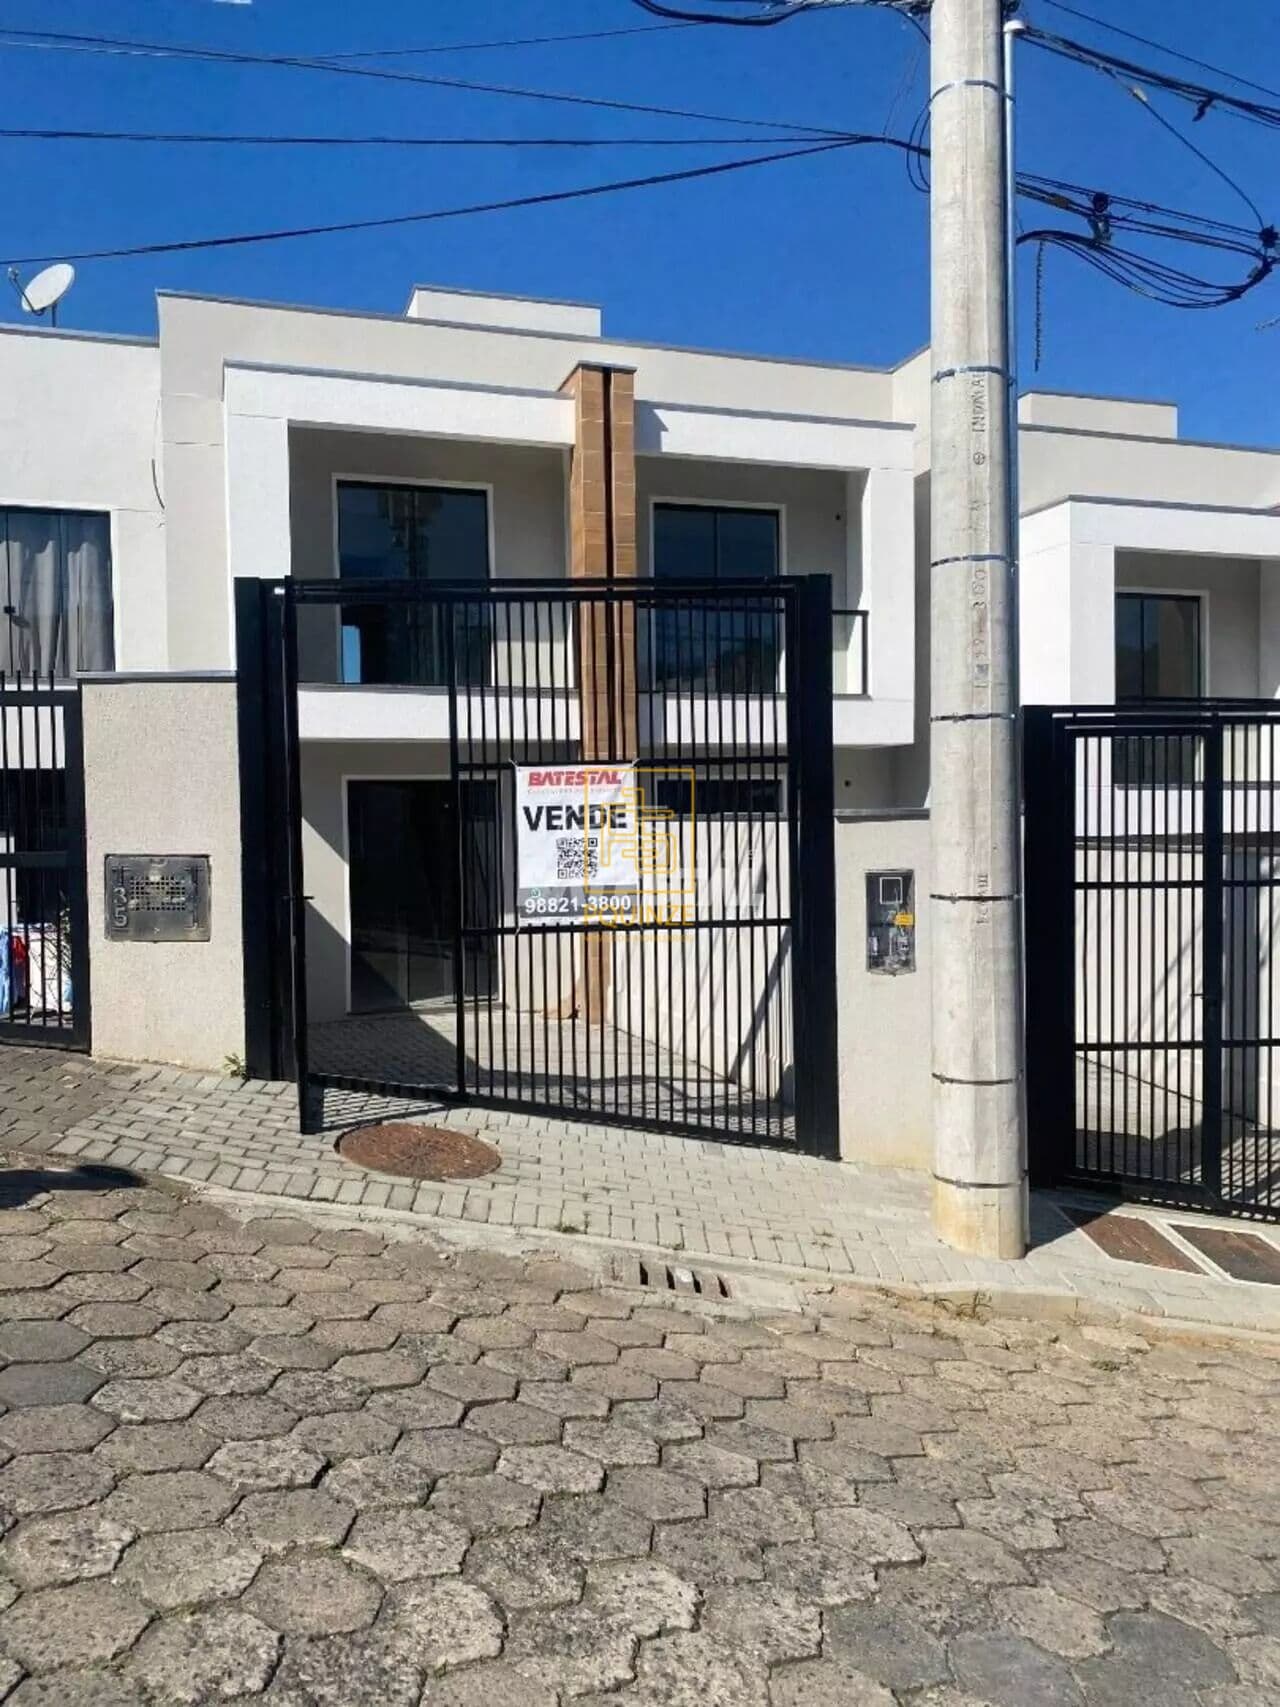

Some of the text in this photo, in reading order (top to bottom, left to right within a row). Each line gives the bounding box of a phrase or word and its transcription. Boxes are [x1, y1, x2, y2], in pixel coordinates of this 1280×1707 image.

[528, 771, 622, 786] BATESTAL
[522, 804, 627, 831] VENDE
[524, 895, 632, 914] 98821-3800
